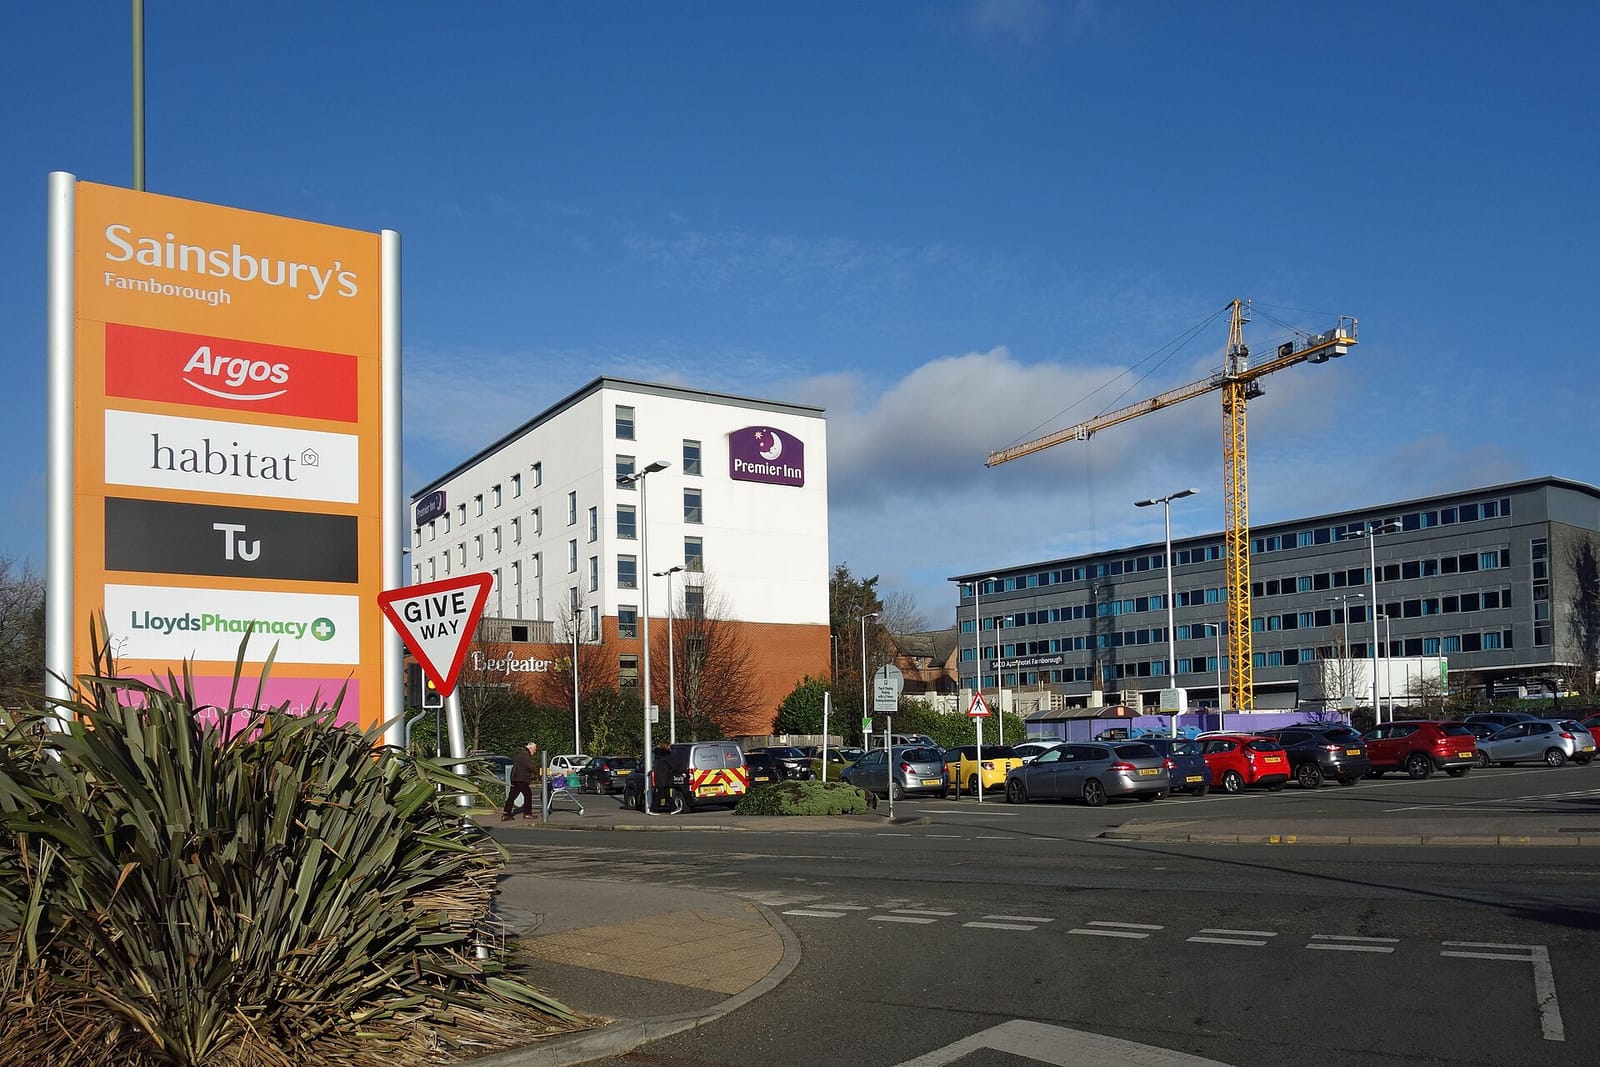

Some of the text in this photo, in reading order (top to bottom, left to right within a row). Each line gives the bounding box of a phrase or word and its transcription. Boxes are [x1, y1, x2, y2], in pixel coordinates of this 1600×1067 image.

[104, 223, 359, 300] Sainsbury's
[104, 272, 231, 306] Farnborough
[182, 346, 290, 387] Argos
[150, 432, 298, 482] habitat
[734, 458, 802, 479] Premier Inn
[212, 522, 261, 561] Tu
[404, 591, 467, 623] GIVE
[131, 611, 308, 639] LloydsPharmacy
[420, 619, 460, 640] WAY
[471, 651, 552, 675] Beefeater
